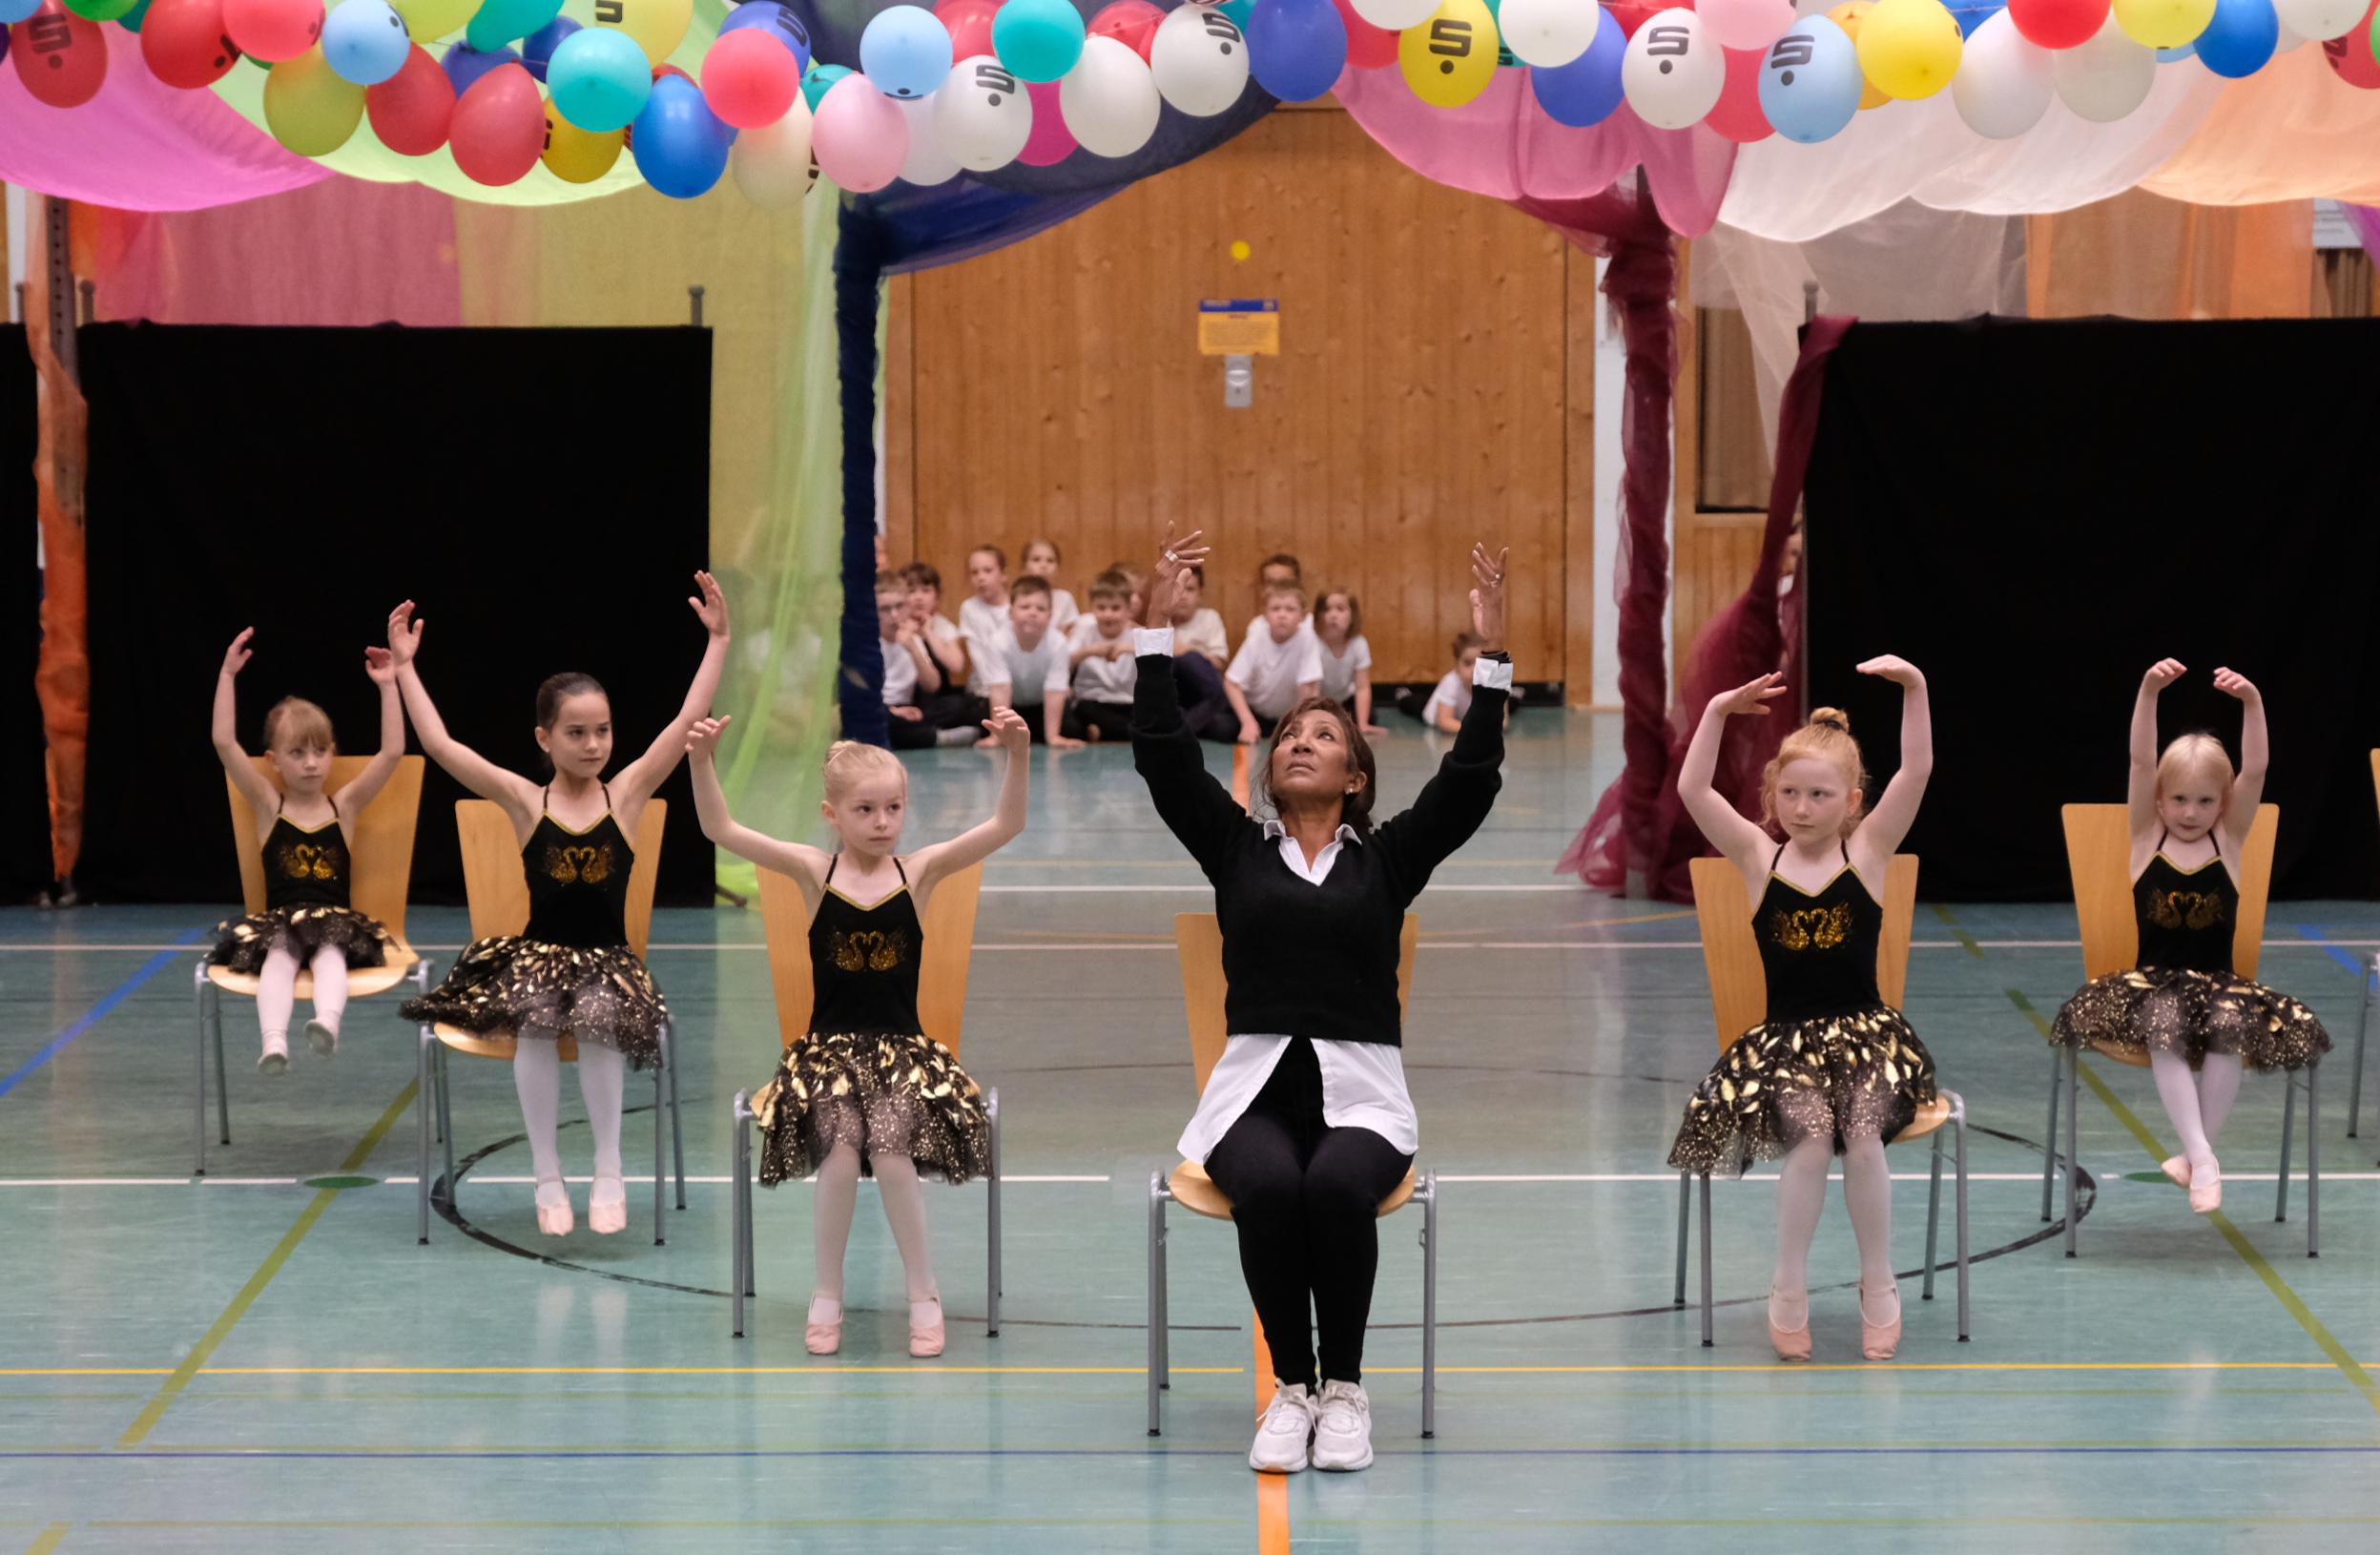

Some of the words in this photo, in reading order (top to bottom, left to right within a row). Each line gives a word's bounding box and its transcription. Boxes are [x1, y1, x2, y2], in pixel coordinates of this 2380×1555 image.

[1429, 18, 1472, 57] S
[1647, 26, 1689, 55] S
[1770, 34, 1815, 69] S
